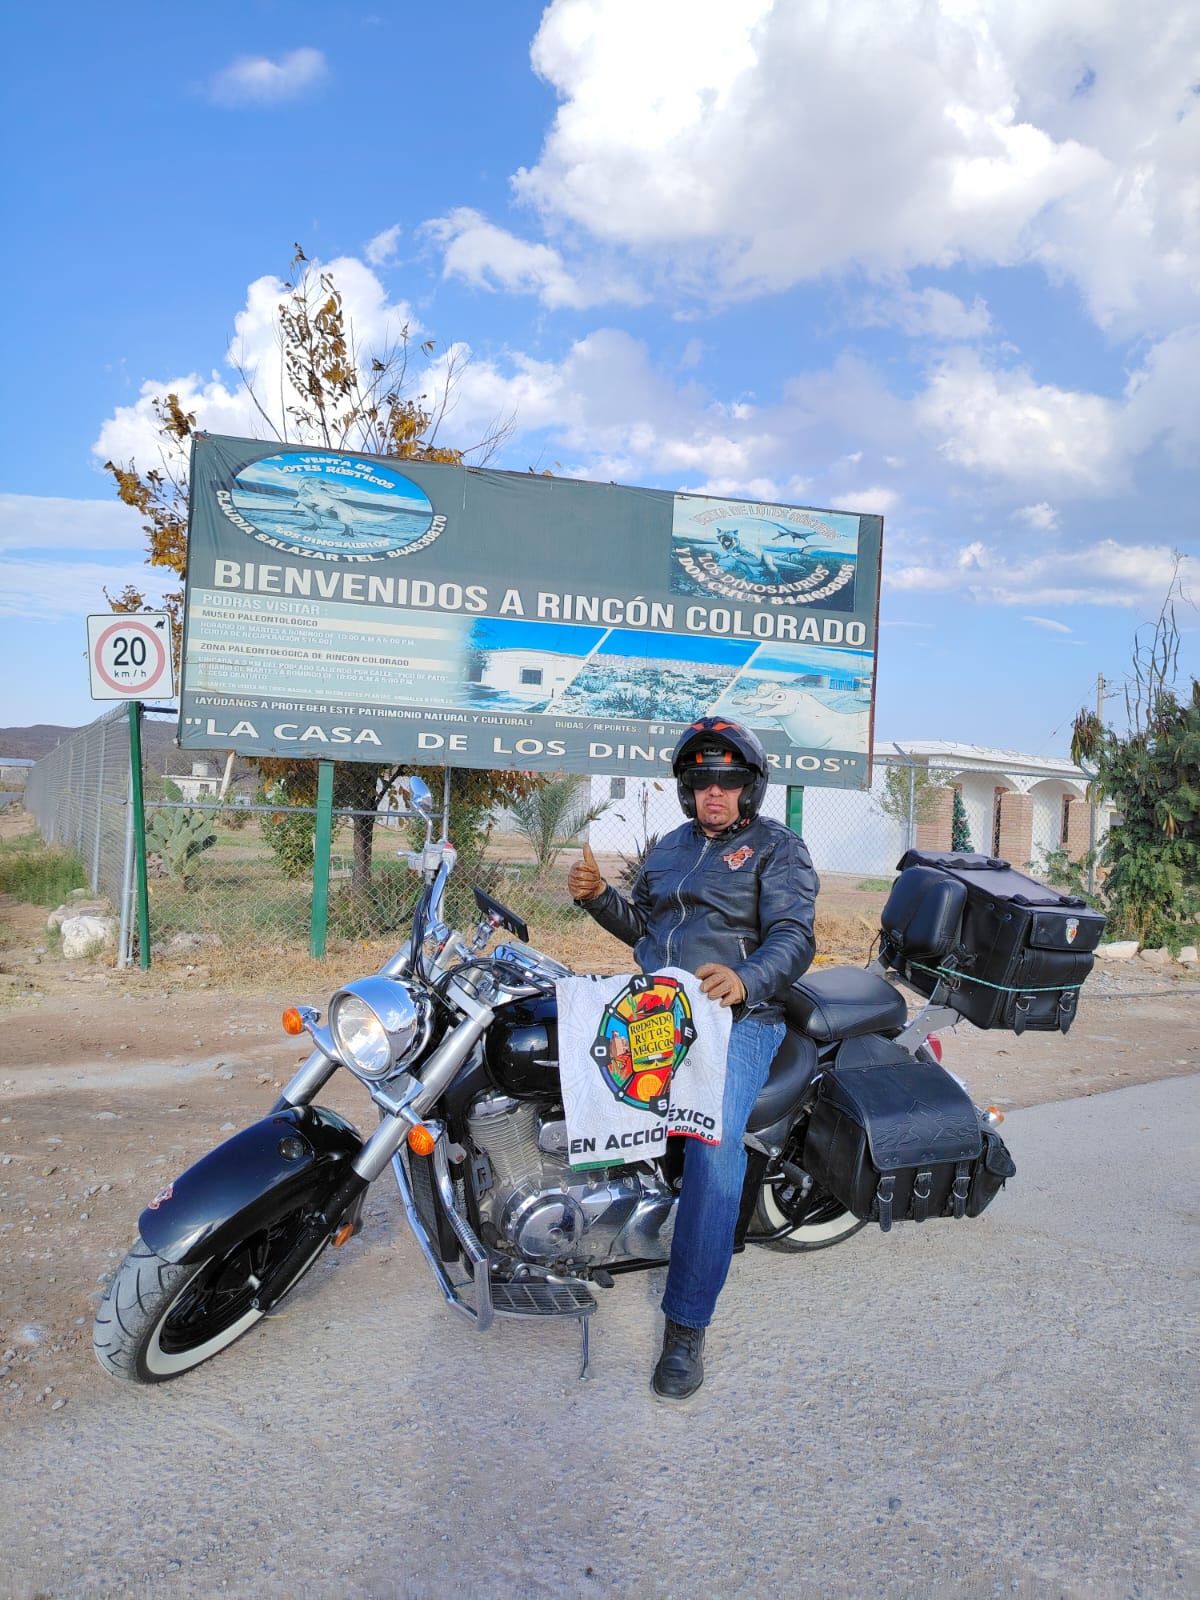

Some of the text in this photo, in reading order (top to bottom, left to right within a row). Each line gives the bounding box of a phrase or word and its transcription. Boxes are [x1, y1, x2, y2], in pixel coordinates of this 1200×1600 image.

[274, 464, 322, 474] LOTES
[299, 456, 374, 473] VENTA DE
[216, 490, 257, 535] CLAUDIA
[254, 533, 339, 563] SALAZAR
[342, 554, 385, 563] TEL.
[679, 557, 710, 582] DON
[707, 581, 766, 603] CHUY
[202, 609, 235, 619] MUSEO
[214, 559, 867, 647] BIENVENIDOS A RINCÓN COLORADO
[113, 636, 147, 667] 20
[200, 642, 226, 652] ZONA
[362, 656, 409, 667] COLORADO
[261, 701, 269, 709] A
[271, 703, 327, 714] PROTEGER
[330, 705, 356, 715] ESTE
[358, 708, 422, 720] PATRIMONIO
[424, 712, 470, 723] NATURAL
[472, 715, 479, 723] Y
[481, 716, 533, 727] CULTURAL!
[555, 721, 584, 729] DUDAS
[273, 723, 384, 746] CASA
[417, 732, 469, 751] DE
[493, 737, 567, 756] LOS
[634, 977, 648, 989] N
[656, 1099, 669, 1111] S
[668, 1103, 716, 1130] ÉXICO
[570, 1137, 597, 1154] EN
